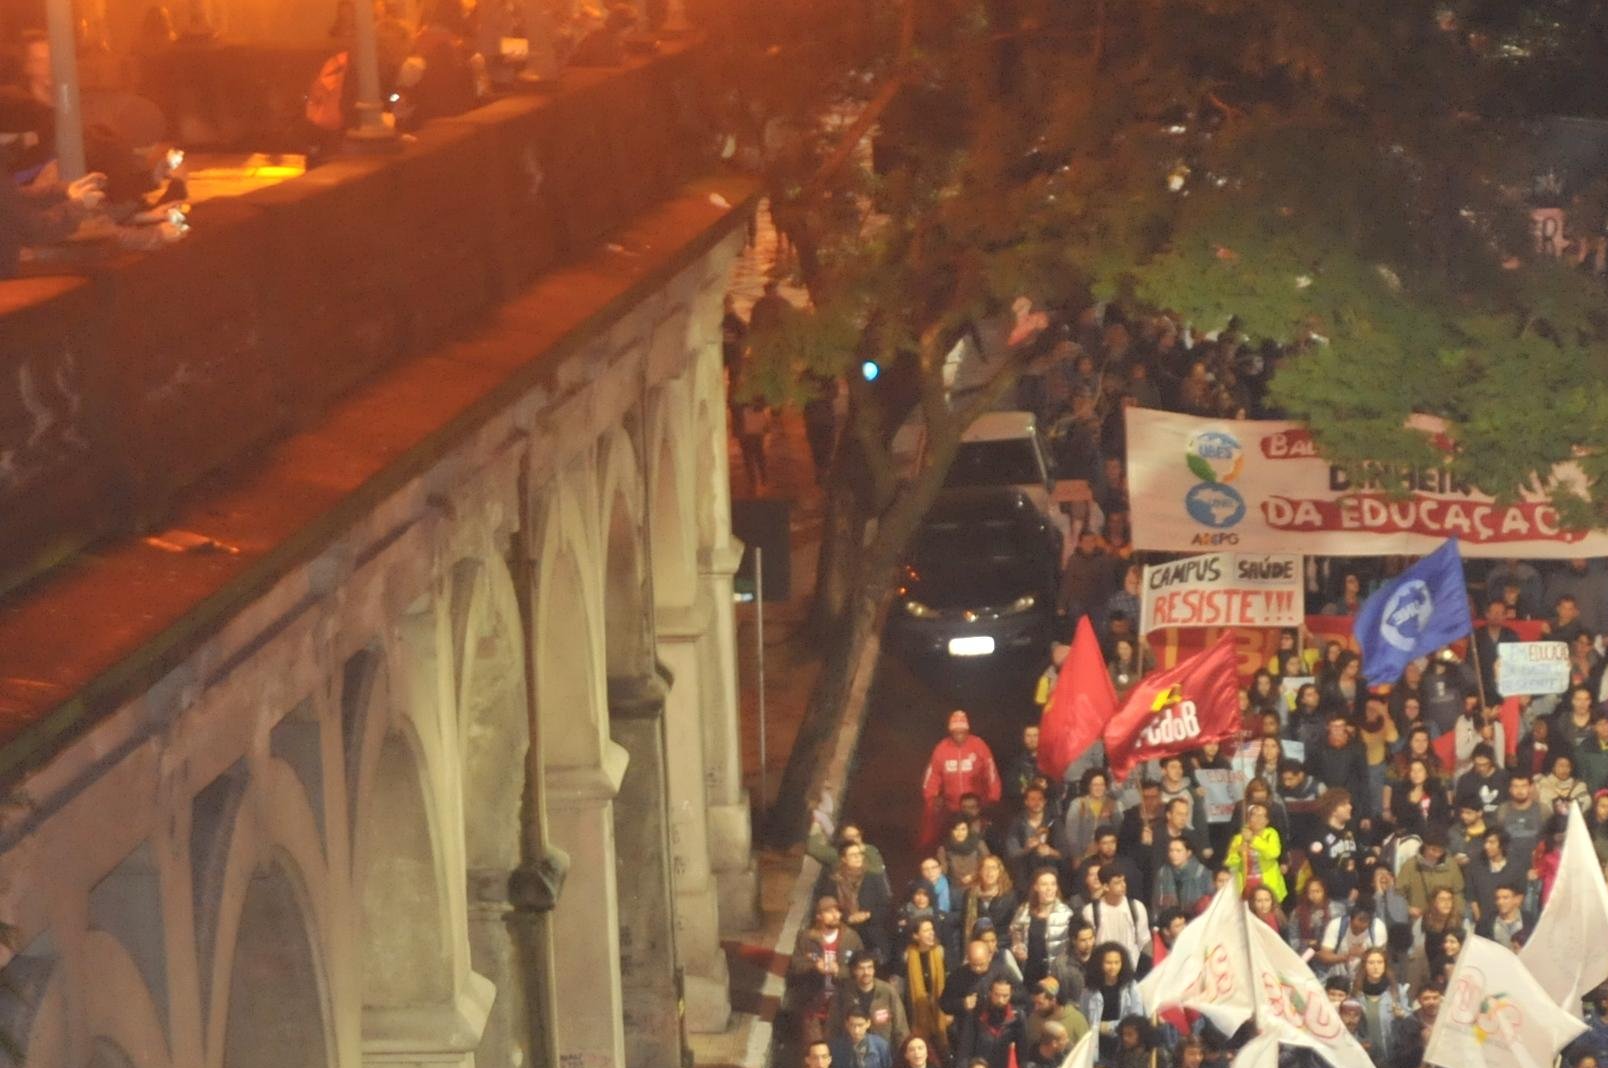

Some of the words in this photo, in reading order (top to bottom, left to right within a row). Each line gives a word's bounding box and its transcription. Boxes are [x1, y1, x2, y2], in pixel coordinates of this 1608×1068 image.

[1266, 496, 1323, 526] DA
[1149, 556, 1221, 590] CAMPUS
[1238, 556, 1294, 581] SAÚDE
